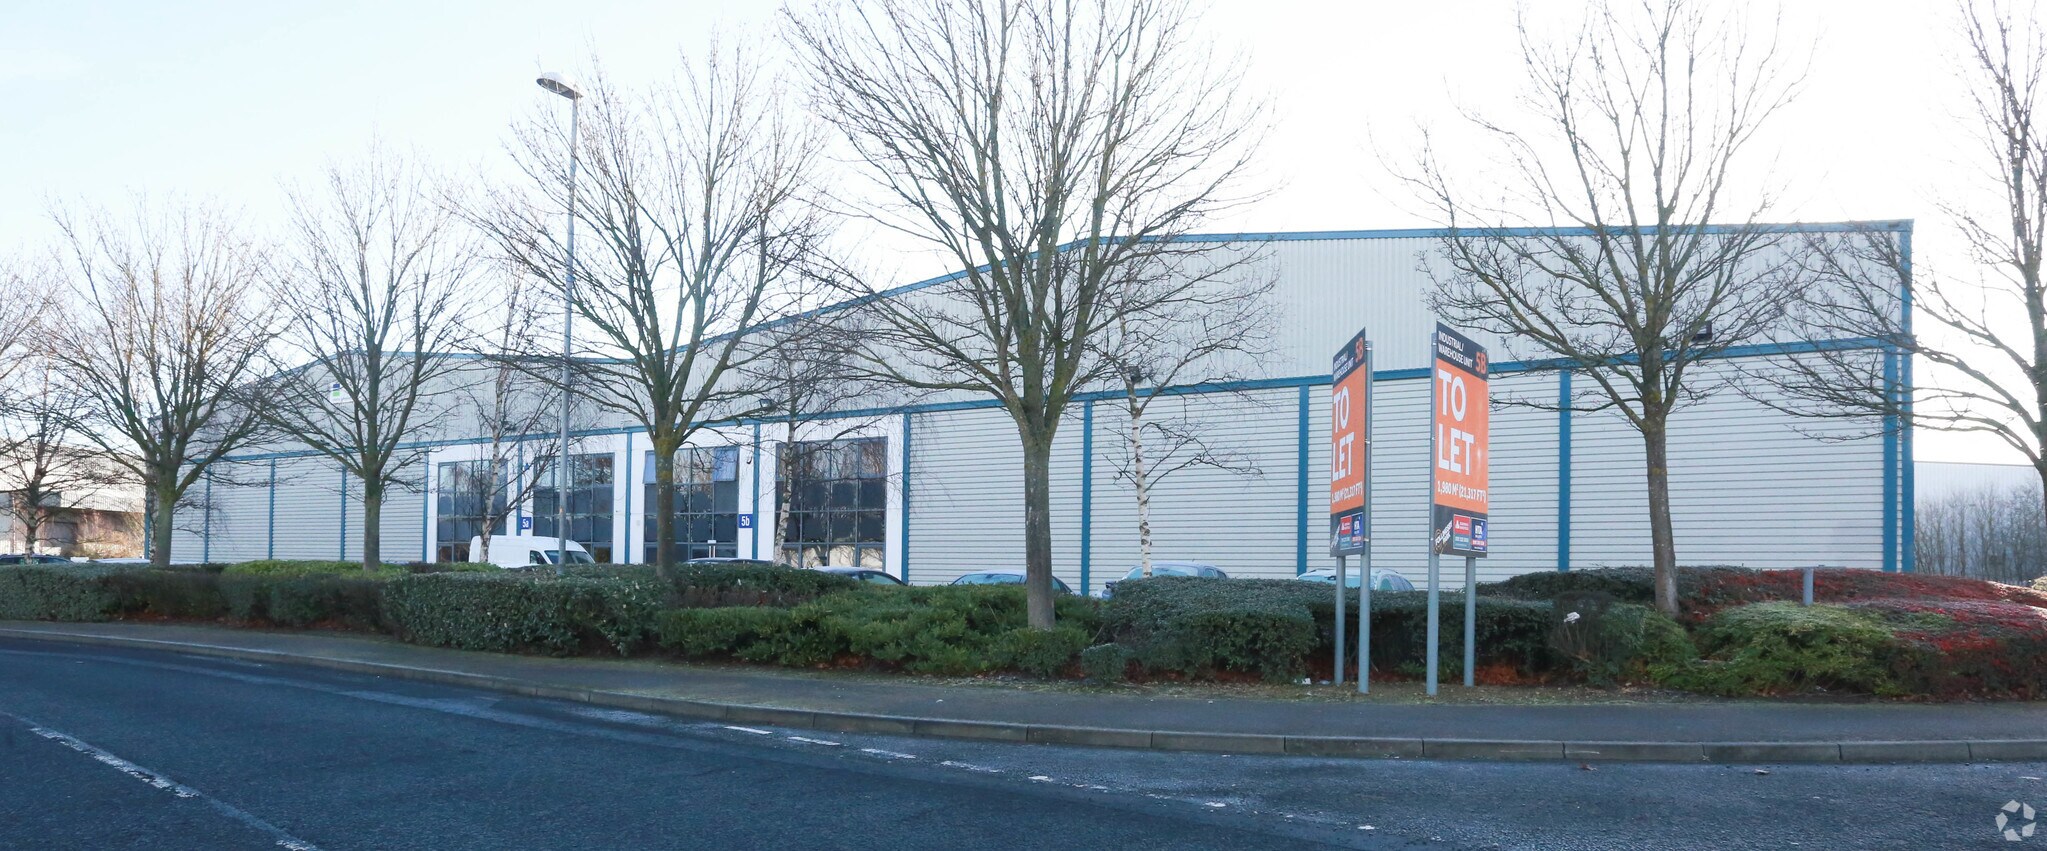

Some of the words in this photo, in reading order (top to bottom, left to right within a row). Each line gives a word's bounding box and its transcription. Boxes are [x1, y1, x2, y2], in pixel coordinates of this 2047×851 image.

[1438, 330, 1465, 352] INDUSTRIAL/
[1438, 343, 1464, 364] WAREHOUSE
[1463, 355, 1473, 369] UNIT
[1475, 351, 1487, 375] 5B
[1438, 368, 1467, 422] TO
[1333, 386, 1350, 433] TO
[1332, 431, 1355, 481] LET
[1438, 423, 1474, 476] LET
[522, 518, 529, 528] 5a
[741, 515, 750, 527] 5b
